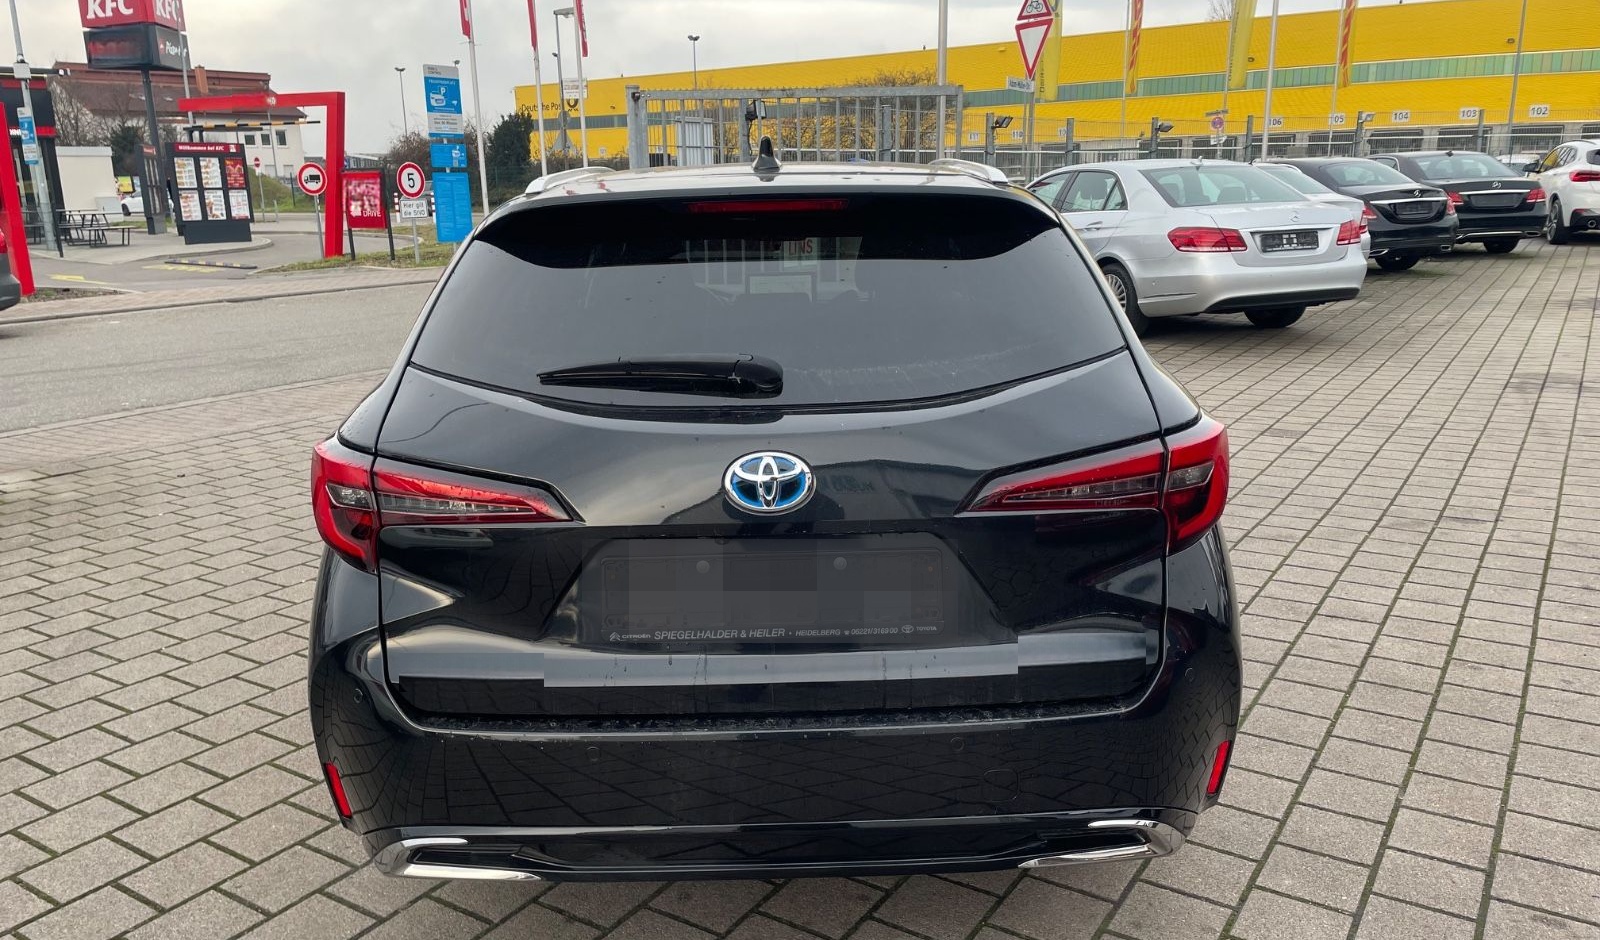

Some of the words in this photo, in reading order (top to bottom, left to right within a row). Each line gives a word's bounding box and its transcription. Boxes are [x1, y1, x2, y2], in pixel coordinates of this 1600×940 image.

[86, 0, 134, 19] KFC
[155, 0, 180, 21] KFC
[1392, 112, 1409, 120] 104
[1461, 109, 1477, 118] 103
[1531, 107, 1548, 115] 102
[406, 172, 416, 188] 5
[654, 629, 738, 640] SPIEGELHALDER
[740, 630, 747, 638] &
[749, 628, 786, 638] HEILER
[795, 629, 841, 637] HEIDELBERG
